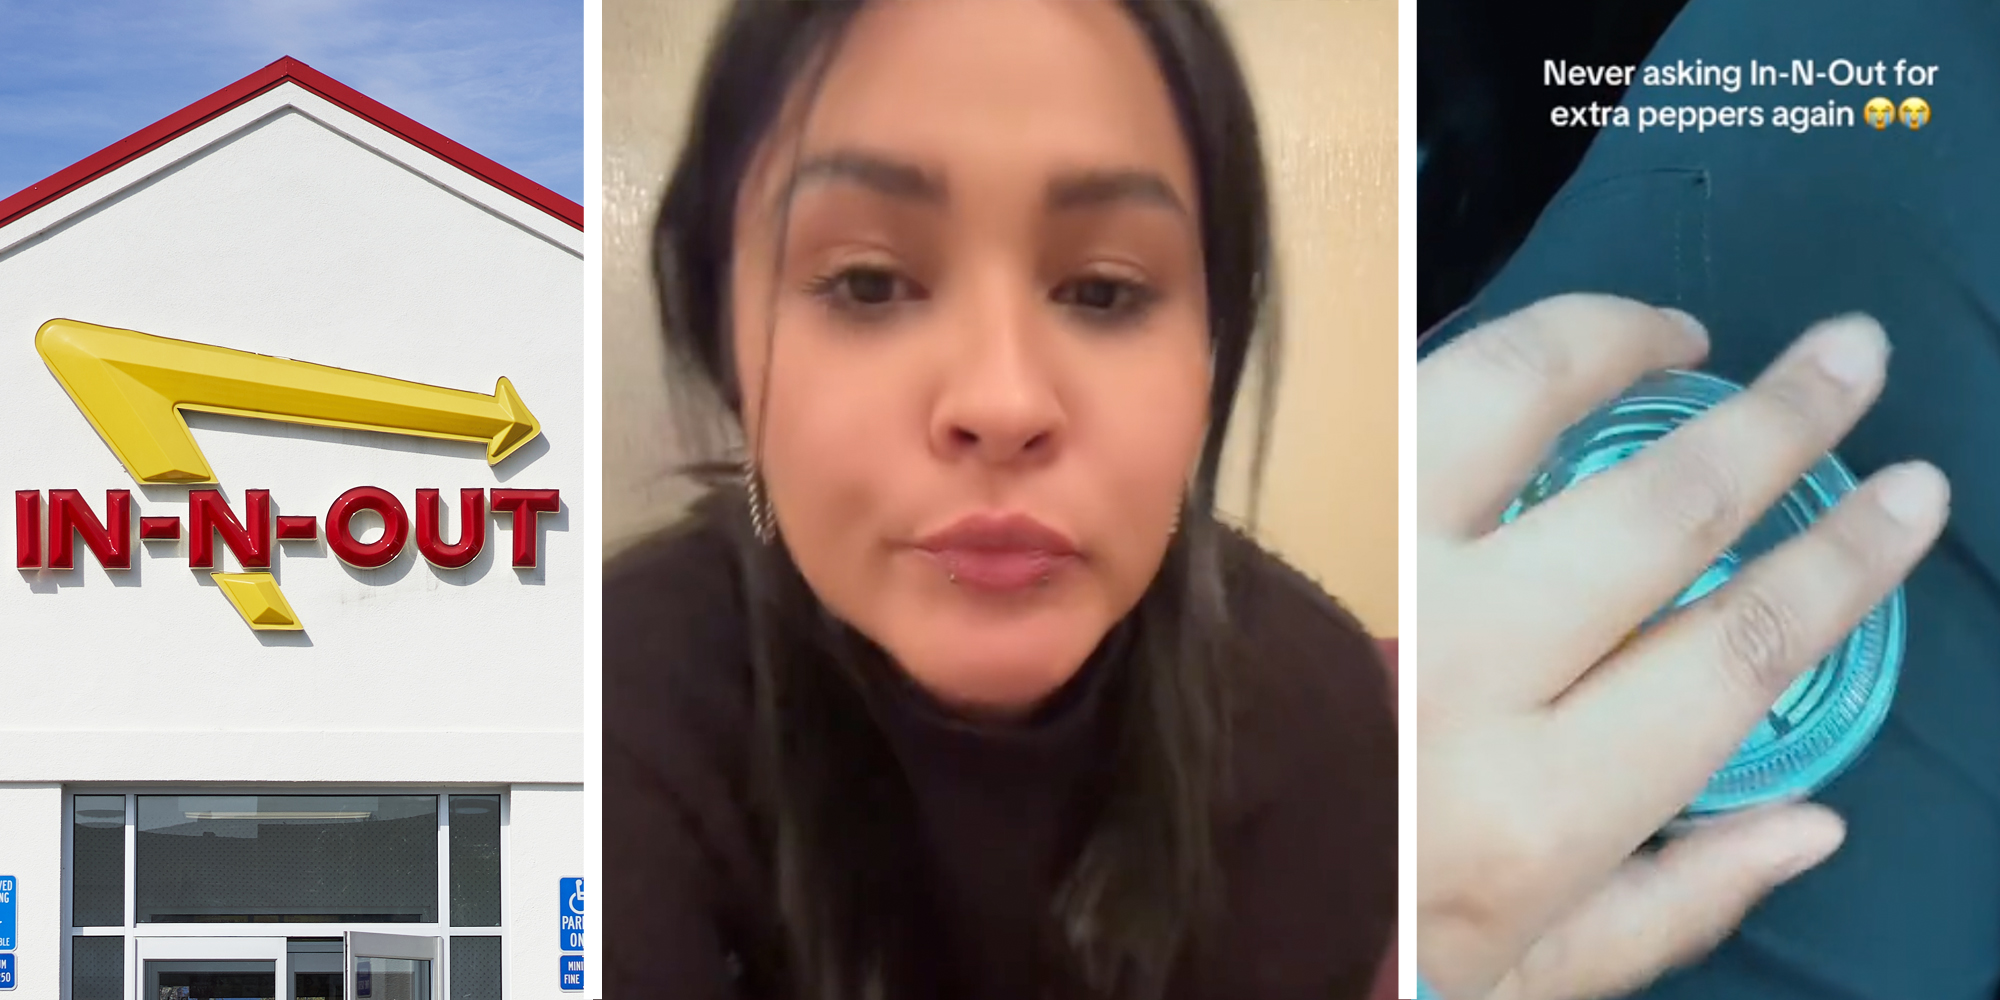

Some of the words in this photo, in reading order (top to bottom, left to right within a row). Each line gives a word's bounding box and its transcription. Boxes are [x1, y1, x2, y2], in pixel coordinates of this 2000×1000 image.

[15, 486, 560, 570] IN-N-OUT
[562, 916, 584, 930] PAR
[564, 974, 580, 984] FINE
